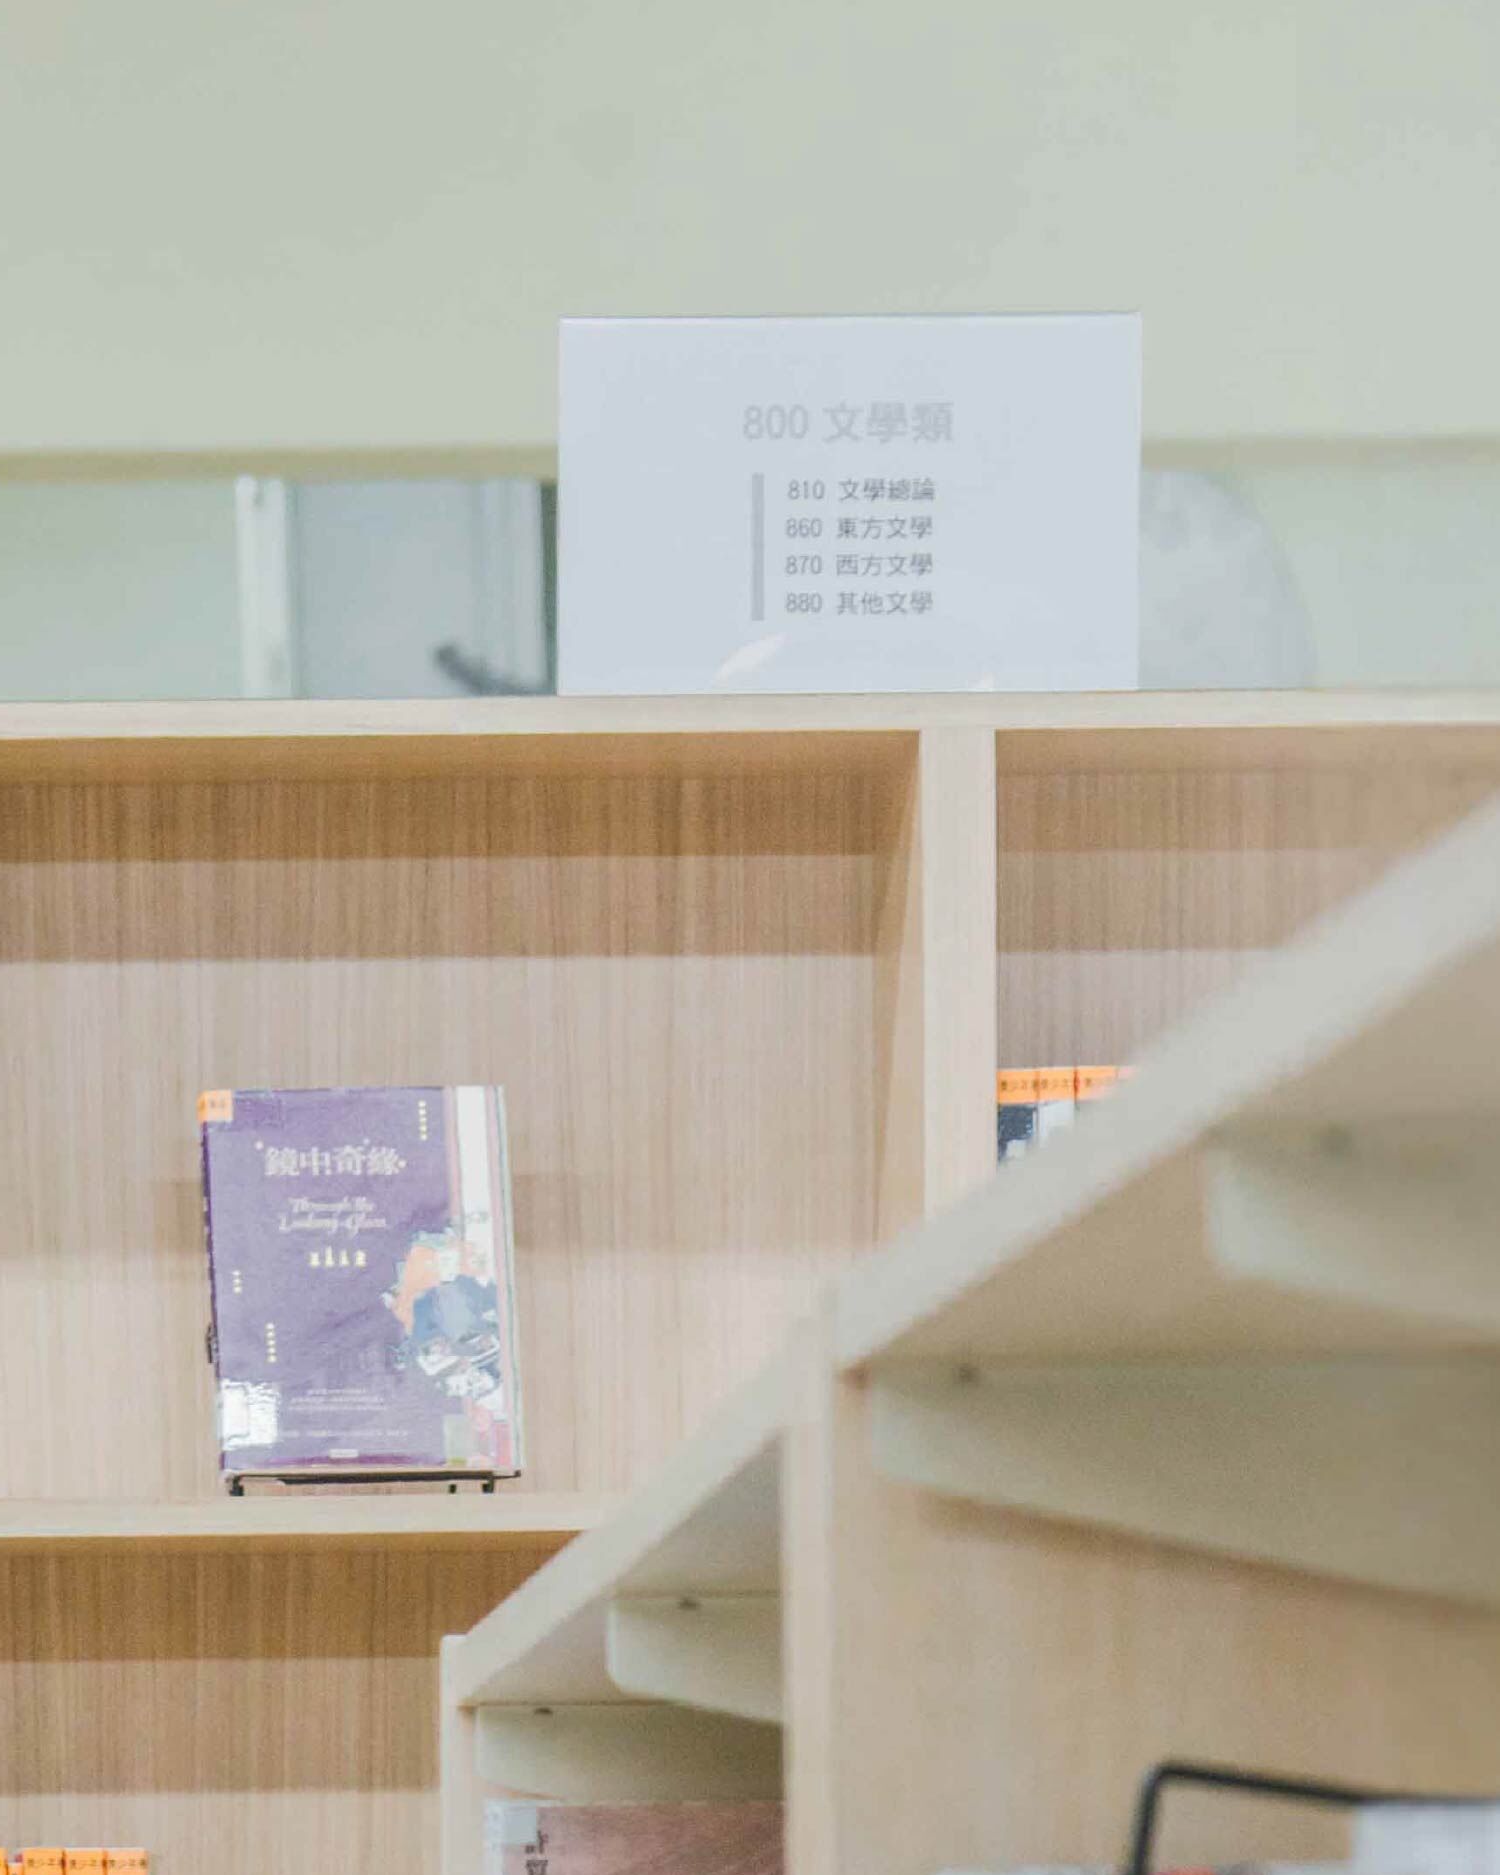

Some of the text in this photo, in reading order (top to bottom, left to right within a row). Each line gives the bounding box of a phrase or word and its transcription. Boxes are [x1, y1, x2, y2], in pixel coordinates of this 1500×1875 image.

[742, 401, 954, 444] 800 文學類
[787, 478, 936, 502] 810 文學總論
[785, 516, 934, 541] 860 東方文學
[784, 554, 934, 578] 870 西方文學
[784, 591, 934, 616] 880 其他文學
[264, 1145, 401, 1176] 鏡中奇緣
